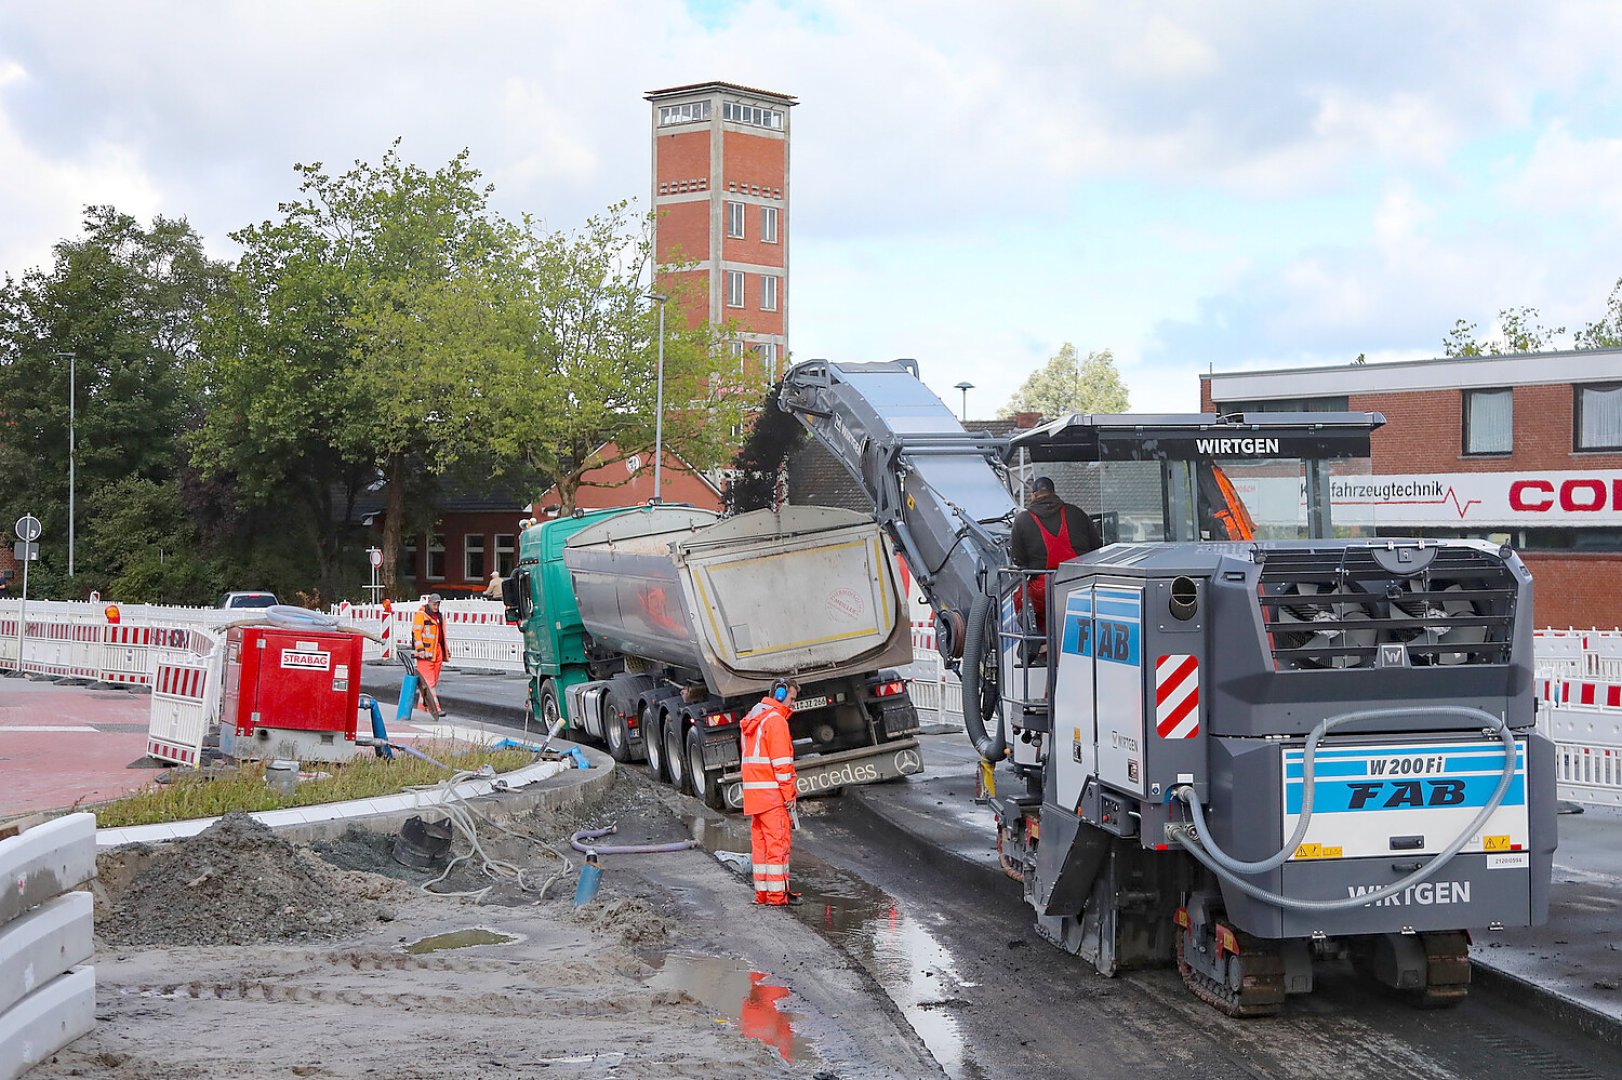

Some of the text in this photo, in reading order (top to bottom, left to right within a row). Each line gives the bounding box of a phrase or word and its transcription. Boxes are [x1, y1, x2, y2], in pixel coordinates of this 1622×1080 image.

[1196, 438, 1279, 454] WIRTGEN
[1301, 481, 1443, 500] Kfahrzeugtechnik
[1509, 479, 1622, 512] CO
[1077, 618, 1130, 661] FAB
[284, 654, 328, 665] STRABAG
[796, 763, 878, 793] ercedes
[1346, 779, 1466, 809] FAB
